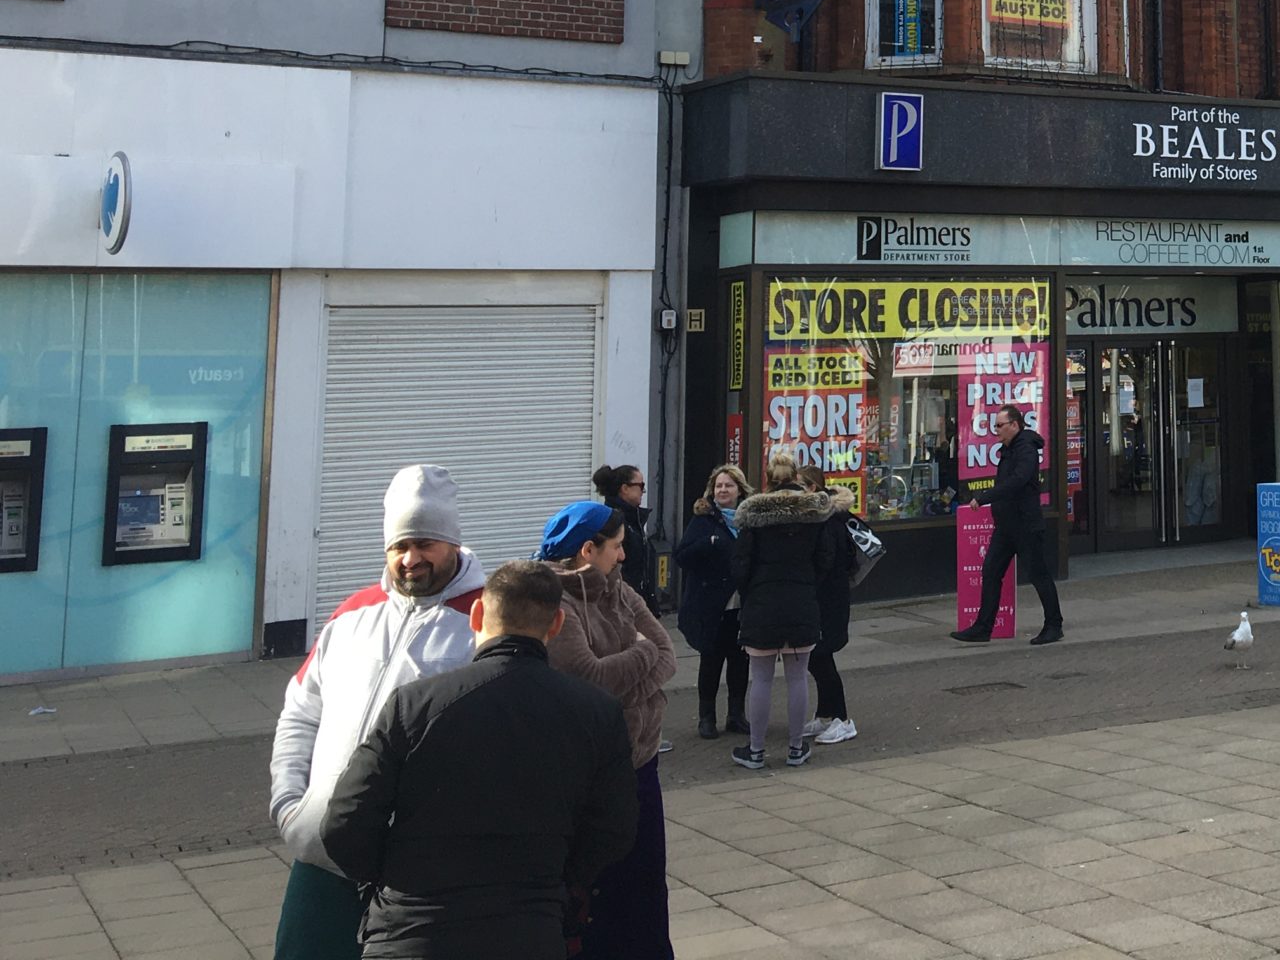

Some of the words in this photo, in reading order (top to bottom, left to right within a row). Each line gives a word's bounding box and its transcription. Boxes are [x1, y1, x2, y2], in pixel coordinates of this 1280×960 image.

[995, 2, 1035, 17] MUST
[1040, 4, 1067, 19] GO!
[906, 22, 917, 52] NOW!
[1171, 106, 1198, 122] Part
[1201, 107, 1216, 123] of
[1218, 109, 1240, 124] the
[888, 100, 917, 163] P
[1132, 123, 1277, 162] BEALES
[1152, 162, 1197, 183] Family
[1200, 164, 1215, 180] of
[1217, 165, 1258, 181] Stores
[883, 217, 971, 247] Palmers
[1095, 220, 1223, 243] RESTAURANT
[1224, 231, 1249, 243] and
[883, 253, 941, 261] DEPARTMENT
[944, 253, 971, 261] STORE
[1118, 243, 1190, 264] COFFEE
[1194, 244, 1251, 264] ROOM
[1253, 245, 1264, 253] 1st
[1252, 255, 1270, 264] Floor
[689, 312, 703, 329] H
[773, 288, 886, 336] STORE
[898, 287, 1047, 334] CLOSING!
[1008, 307, 1032, 315] SHOP
[772, 357, 802, 370] ALL
[807, 355, 860, 370] STOCK
[975, 351, 1036, 375] NEW
[772, 370, 860, 388] REDUCED!
[967, 381, 1044, 406] PRICE
[768, 393, 863, 440] STORE
[968, 479, 995, 491] WHEN
